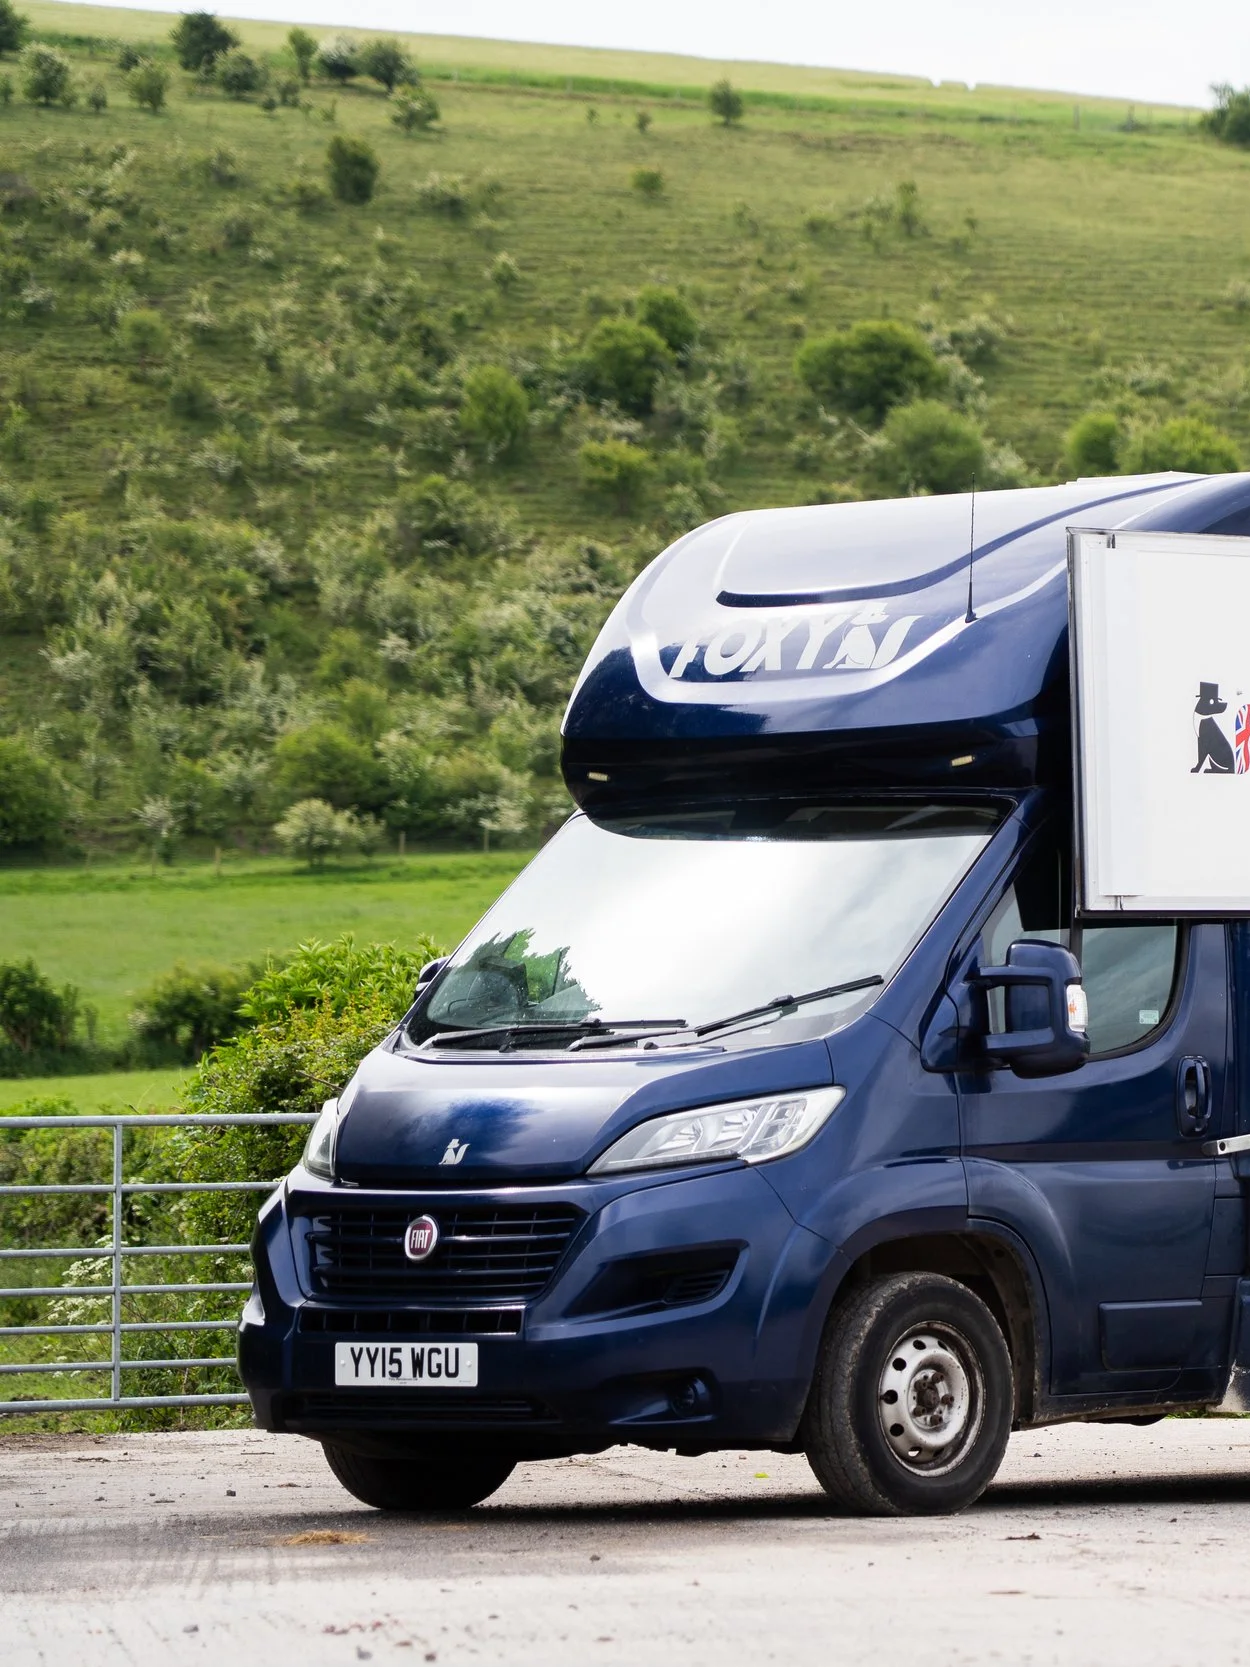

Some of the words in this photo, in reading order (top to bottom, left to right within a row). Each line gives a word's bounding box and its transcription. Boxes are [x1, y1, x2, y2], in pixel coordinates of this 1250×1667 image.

[410, 1229, 431, 1249] FIAT
[350, 1347, 402, 1378] YY15
[411, 1347, 460, 1378] WGU
